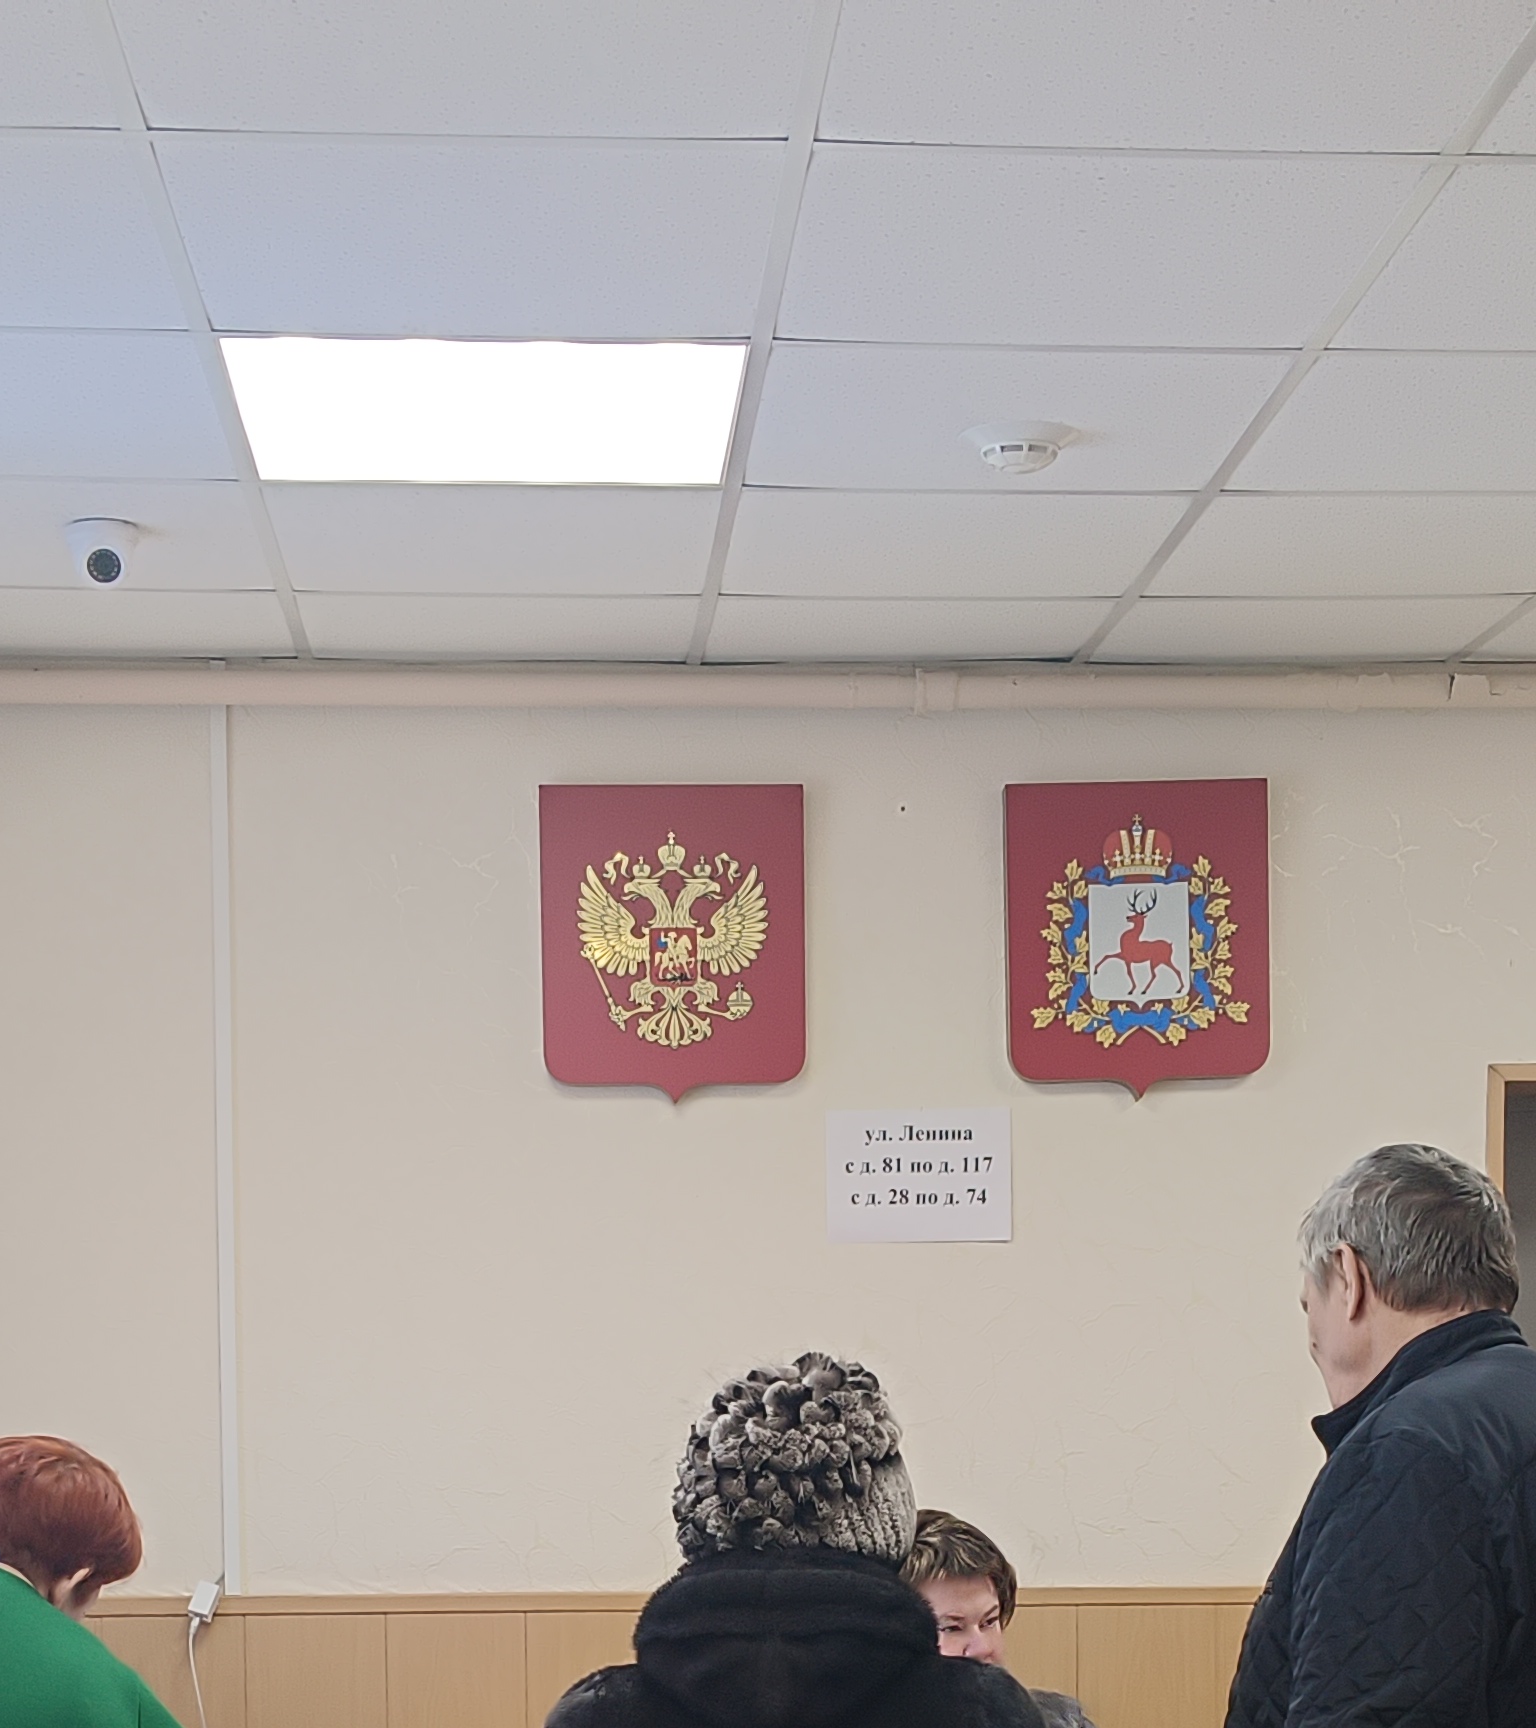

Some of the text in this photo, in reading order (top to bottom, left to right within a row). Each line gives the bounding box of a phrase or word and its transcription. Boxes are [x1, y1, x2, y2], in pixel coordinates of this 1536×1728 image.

[864, 1124, 973, 1146] ул. Ленина
[845, 1156, 993, 1176] с д. 81 по д. 117
[851, 1188, 987, 1207] с д. 28 по д. 74
